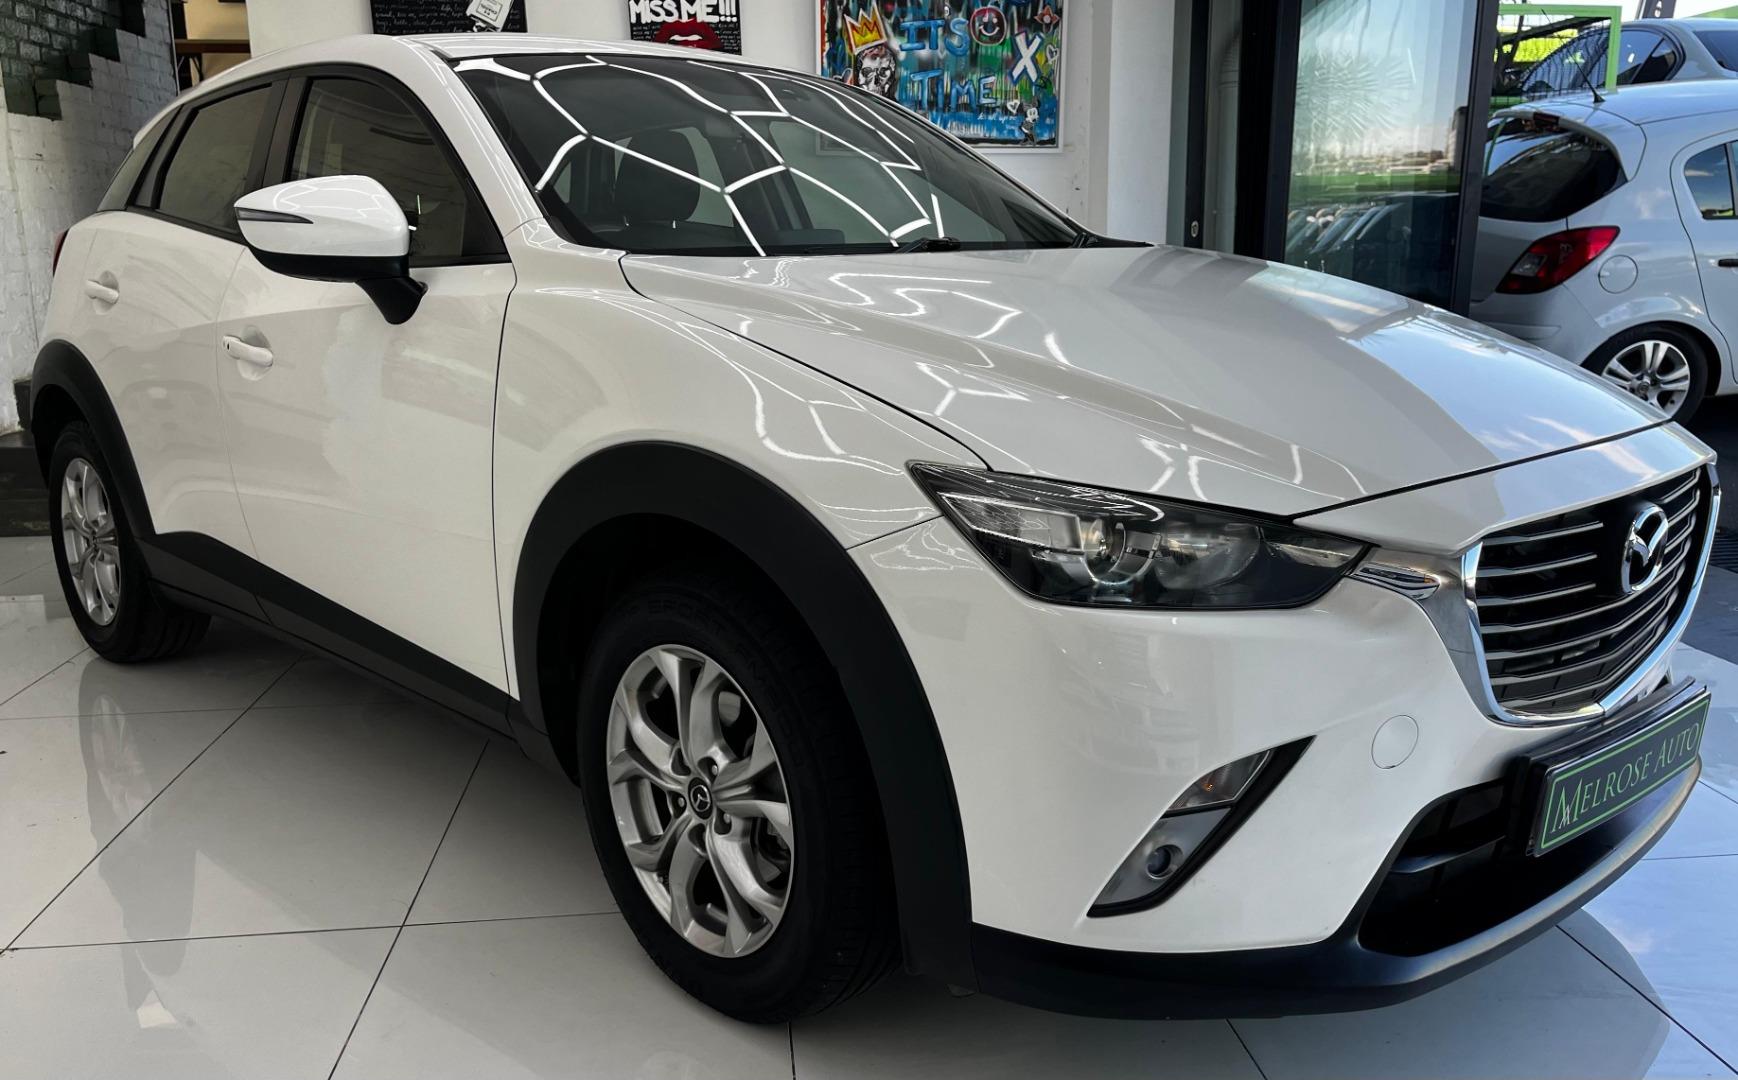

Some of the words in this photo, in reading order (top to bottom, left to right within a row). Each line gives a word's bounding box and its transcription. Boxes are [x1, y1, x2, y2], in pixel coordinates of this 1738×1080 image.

[629, 0, 679, 24] MISS
[680, 0, 738, 23] ME!!!
[900, 18, 970, 57] ITS
[1008, 31, 1044, 85] X
[910, 69, 998, 112] TIME
[1551, 750, 1653, 834] MELROSE
[1654, 721, 1700, 773] AUTO
